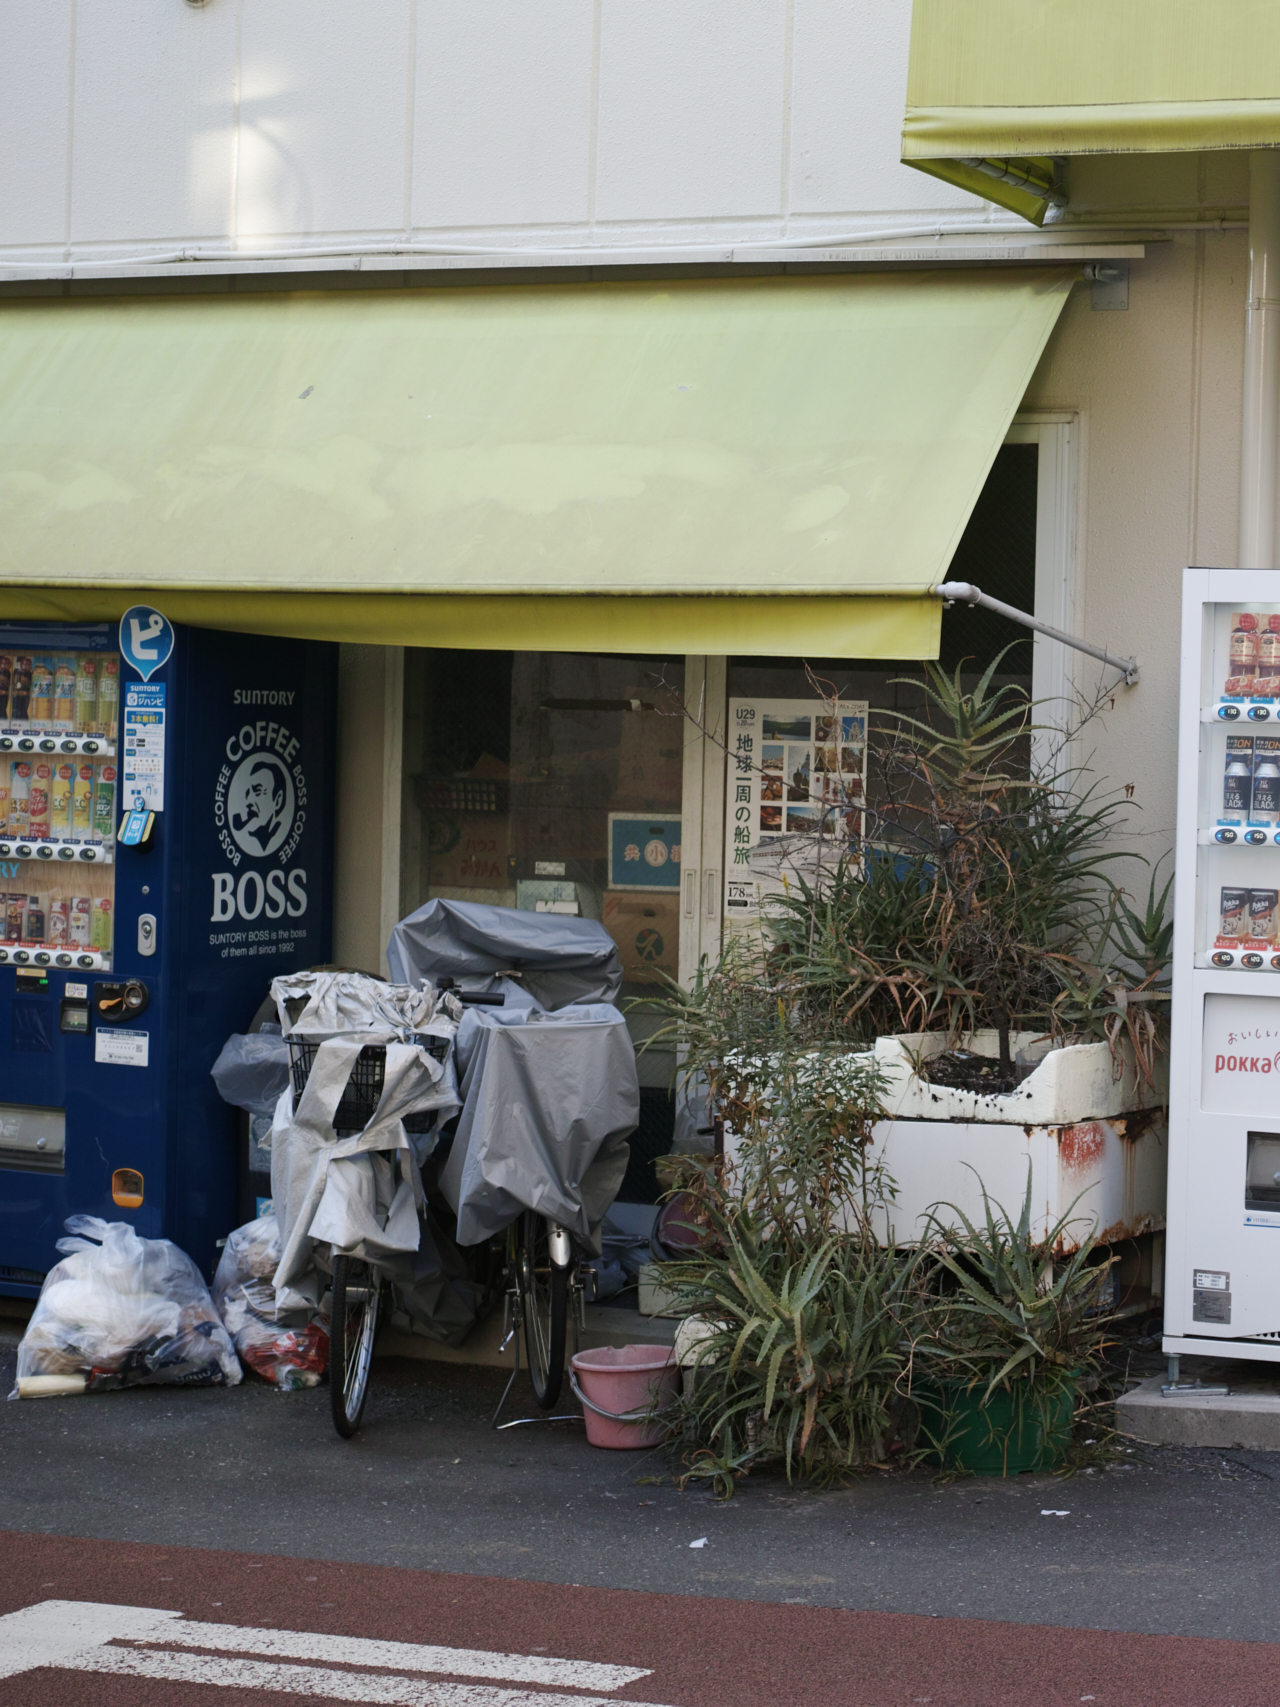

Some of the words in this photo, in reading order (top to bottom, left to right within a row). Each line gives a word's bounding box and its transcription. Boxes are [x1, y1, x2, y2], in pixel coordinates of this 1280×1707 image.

[130, 614, 164, 660] ピ
[138, 697, 164, 706] ジハンピ
[234, 689, 295, 706] SUNTORY
[736, 709, 756, 720] U29
[226, 721, 300, 764] COFFEE
[1237, 740, 1251, 748] ON
[293, 764, 307, 805] BOSS
[215, 764, 231, 826] COFFEE
[735, 734, 754, 865] 地球一周の船旅
[279, 810, 306, 865] COFFEE
[219, 828, 242, 867] BOSS
[210, 868, 307, 922] BOSS
[728, 887, 746, 897] 178
[1224, 899, 1239, 909] Pokka
[1252, 901, 1269, 910] Pokka
[210, 933, 247, 945] SUNTORY
[248, 931, 269, 942] BOSS
[271, 930, 277, 940] is
[278, 930, 289, 939] the
[290, 929, 307, 939] boss
[221, 947, 229, 958] of
[230, 946, 247, 957] them
[249, 945, 257, 955] all
[259, 944, 277, 954] since
[278, 943, 294, 953] 1992
